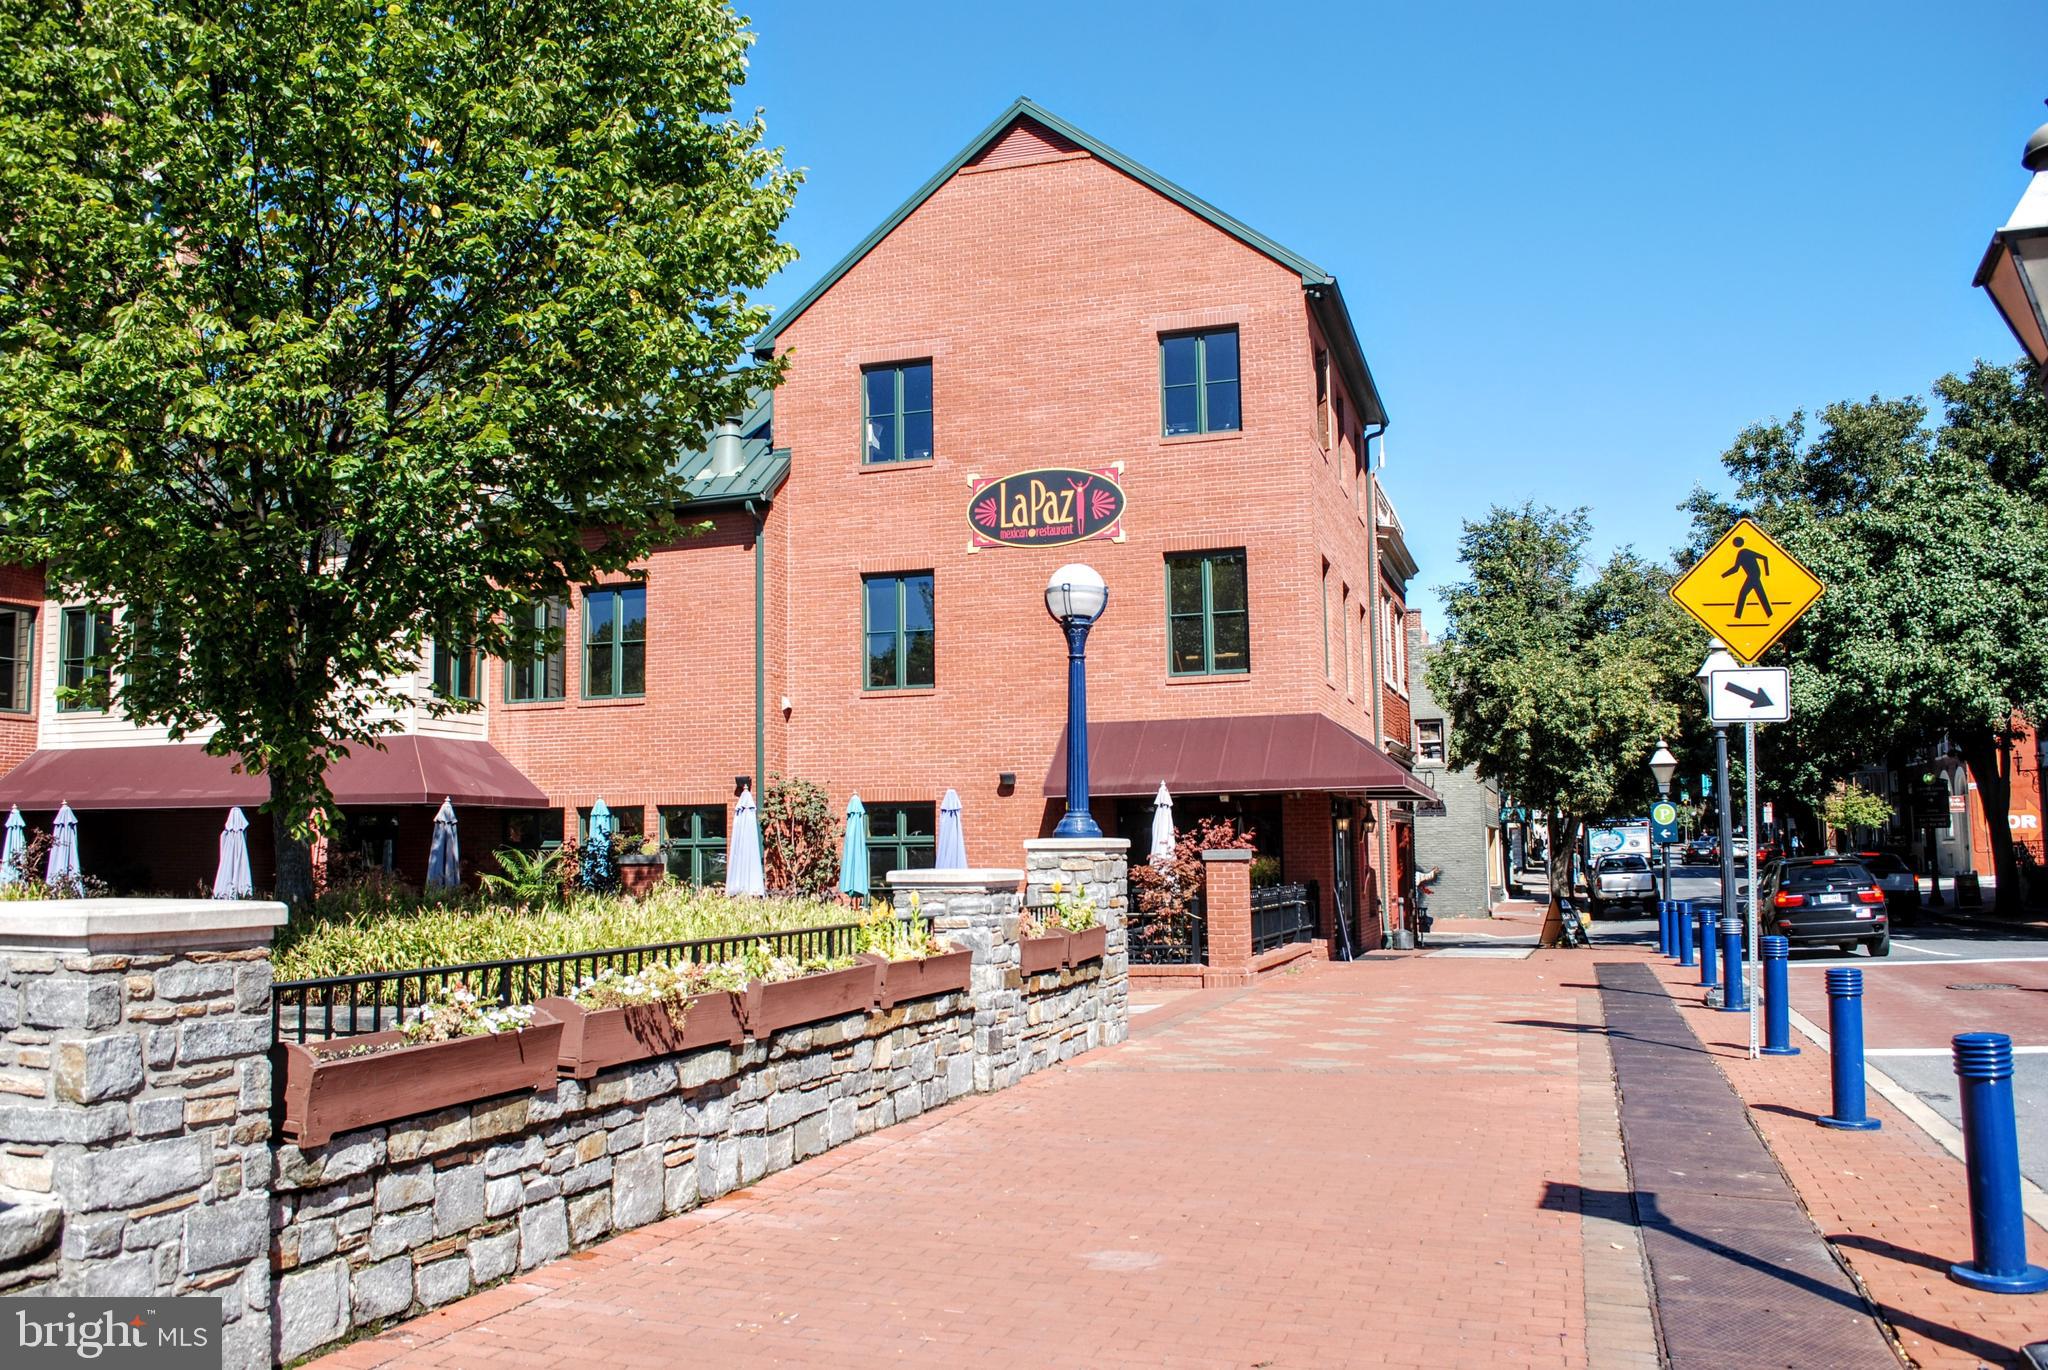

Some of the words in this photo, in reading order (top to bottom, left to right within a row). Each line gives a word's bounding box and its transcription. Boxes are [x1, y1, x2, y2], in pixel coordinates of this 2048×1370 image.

[1000, 526, 1029, 539] mexican
[1035, 523, 1074, 537] restaurant
[1659, 808, 1670, 820] P
